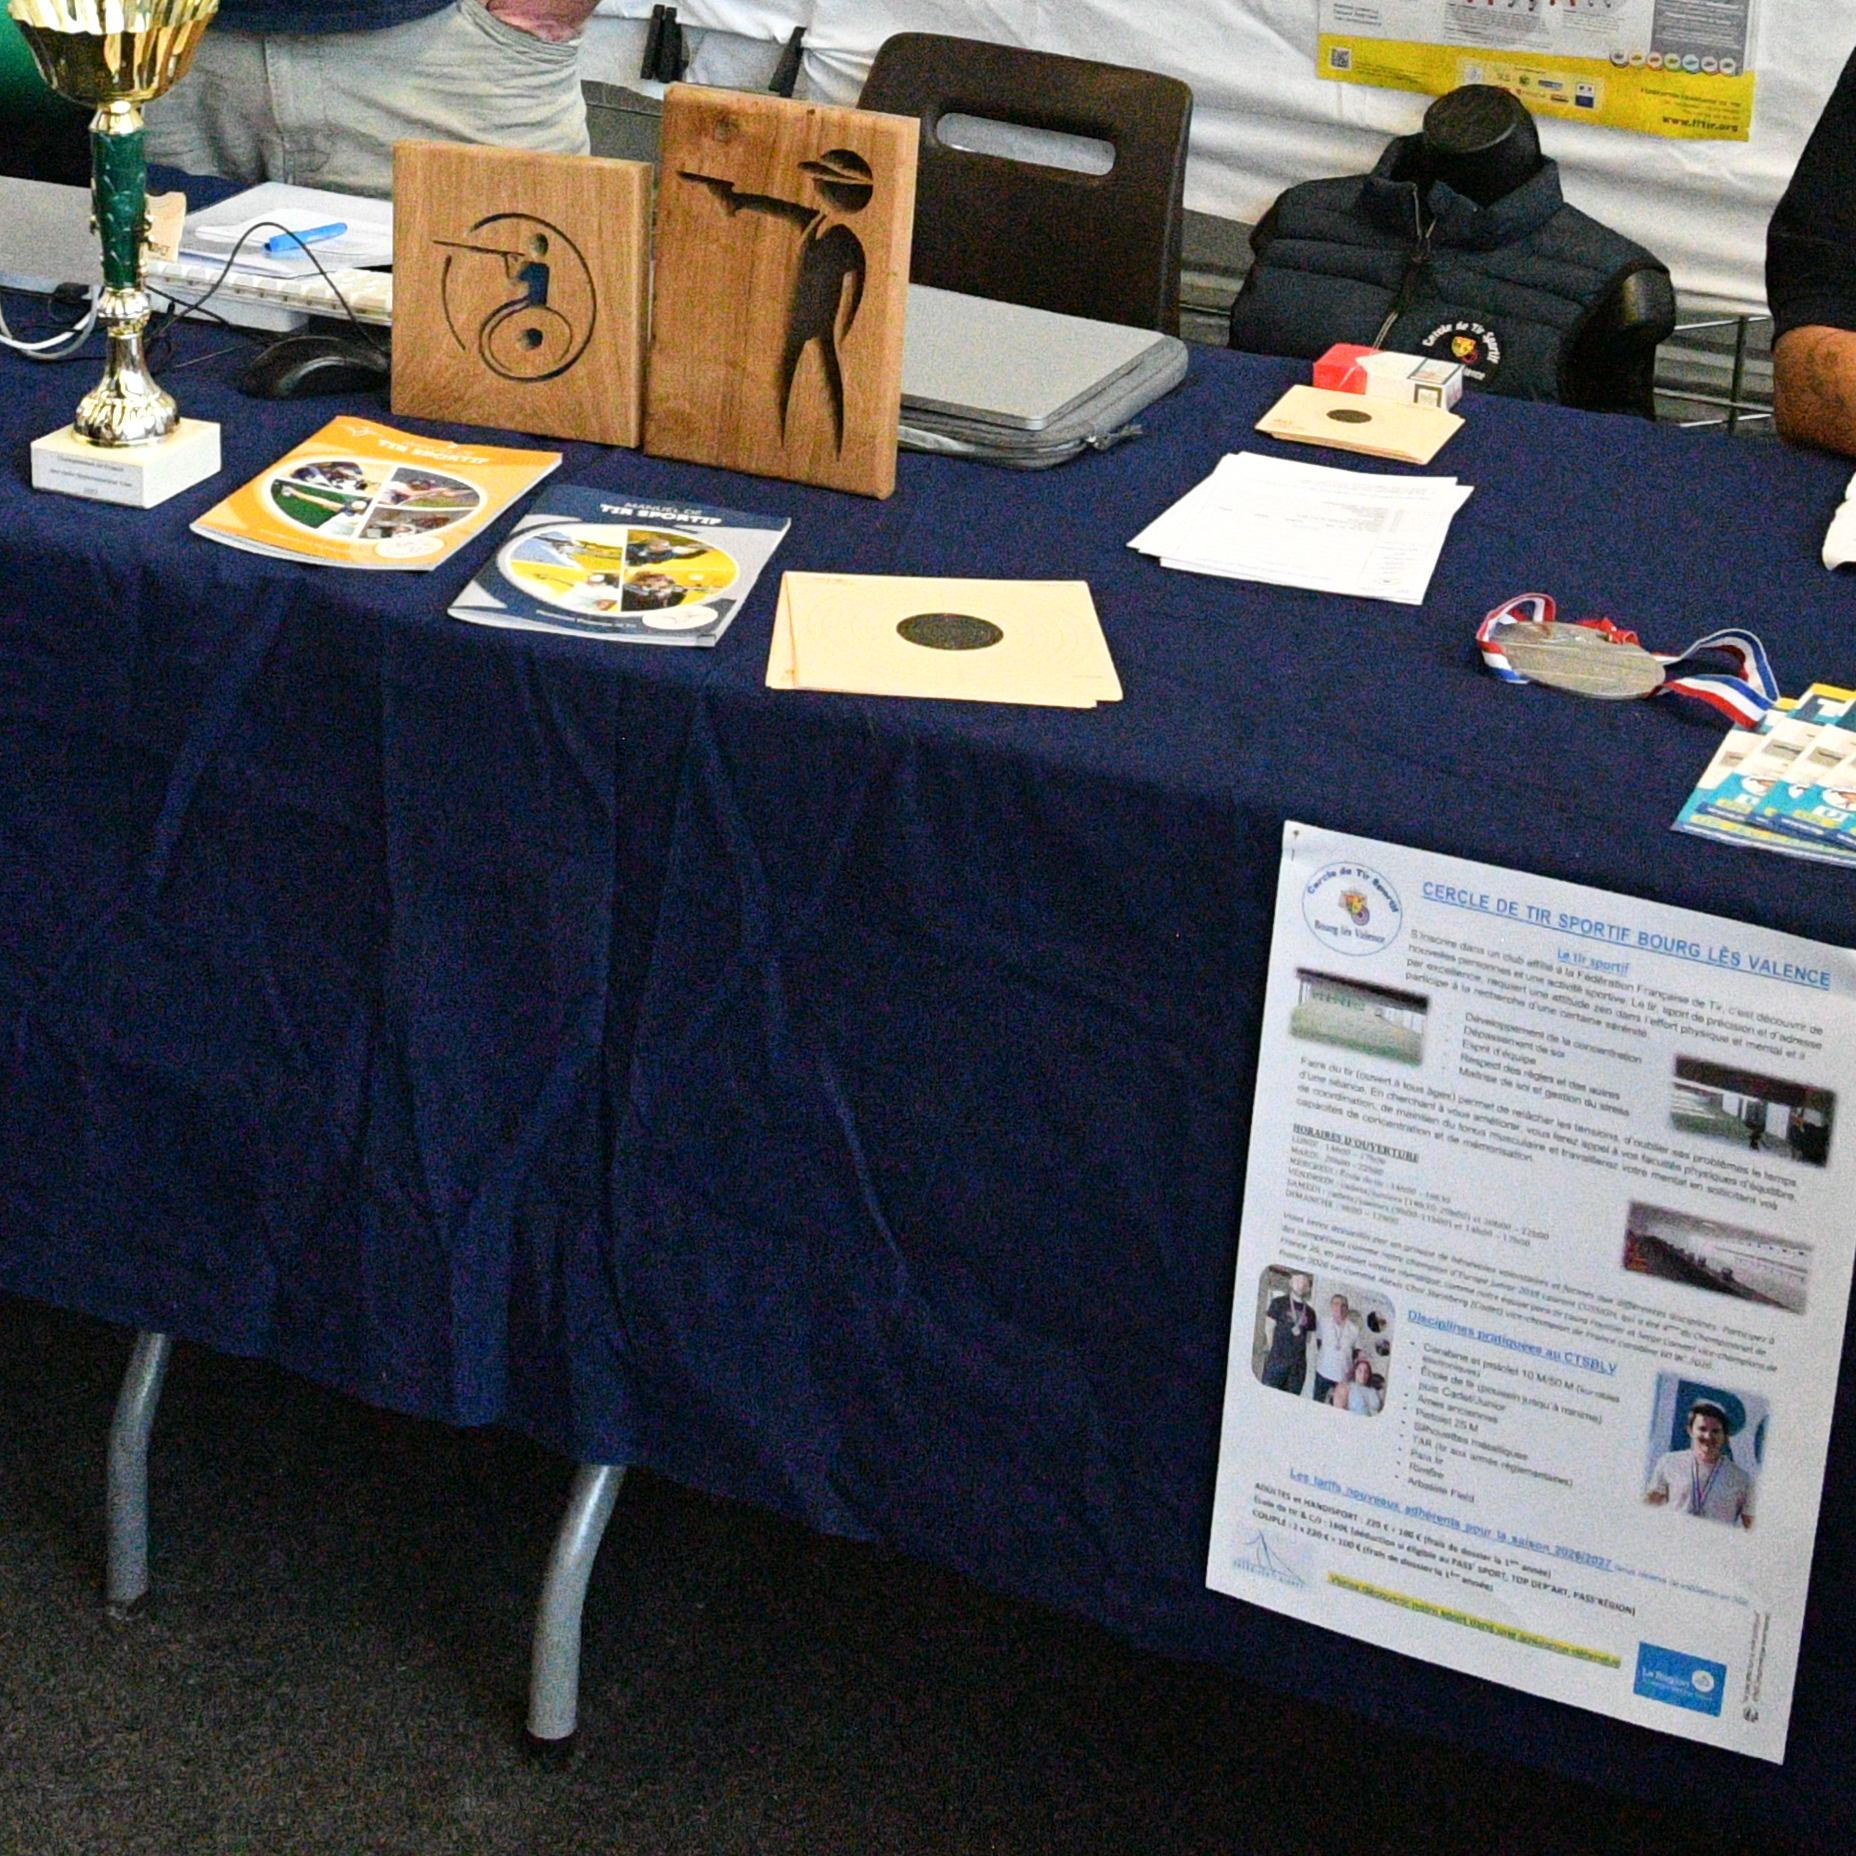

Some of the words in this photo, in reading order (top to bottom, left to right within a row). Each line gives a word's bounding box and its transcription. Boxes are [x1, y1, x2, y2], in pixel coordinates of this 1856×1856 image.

[600, 504, 632, 517] TIR
[636, 509, 722, 526] SPORTIF
[624, 501, 682, 515] MANUEL
[1422, 880, 1489, 909] CERCLE
[1496, 898, 1518, 916] DE
[1525, 905, 1551, 924] TIR
[1558, 913, 1629, 942] SPORTIF
[1637, 930, 1701, 958] BOURG
[1707, 942, 1742, 968] LÈS
[1747, 955, 1830, 987] VALENCE
[1459, 941, 1484, 955] dans
[1557, 948, 1570, 960] Le
[1573, 952, 1588, 965] tir
[1589, 955, 1630, 976] sportif
[1407, 1309, 1475, 1338] Disciplines
[1545, 1348, 1561, 1360] au
[1290, 1467, 1309, 1484] Les
